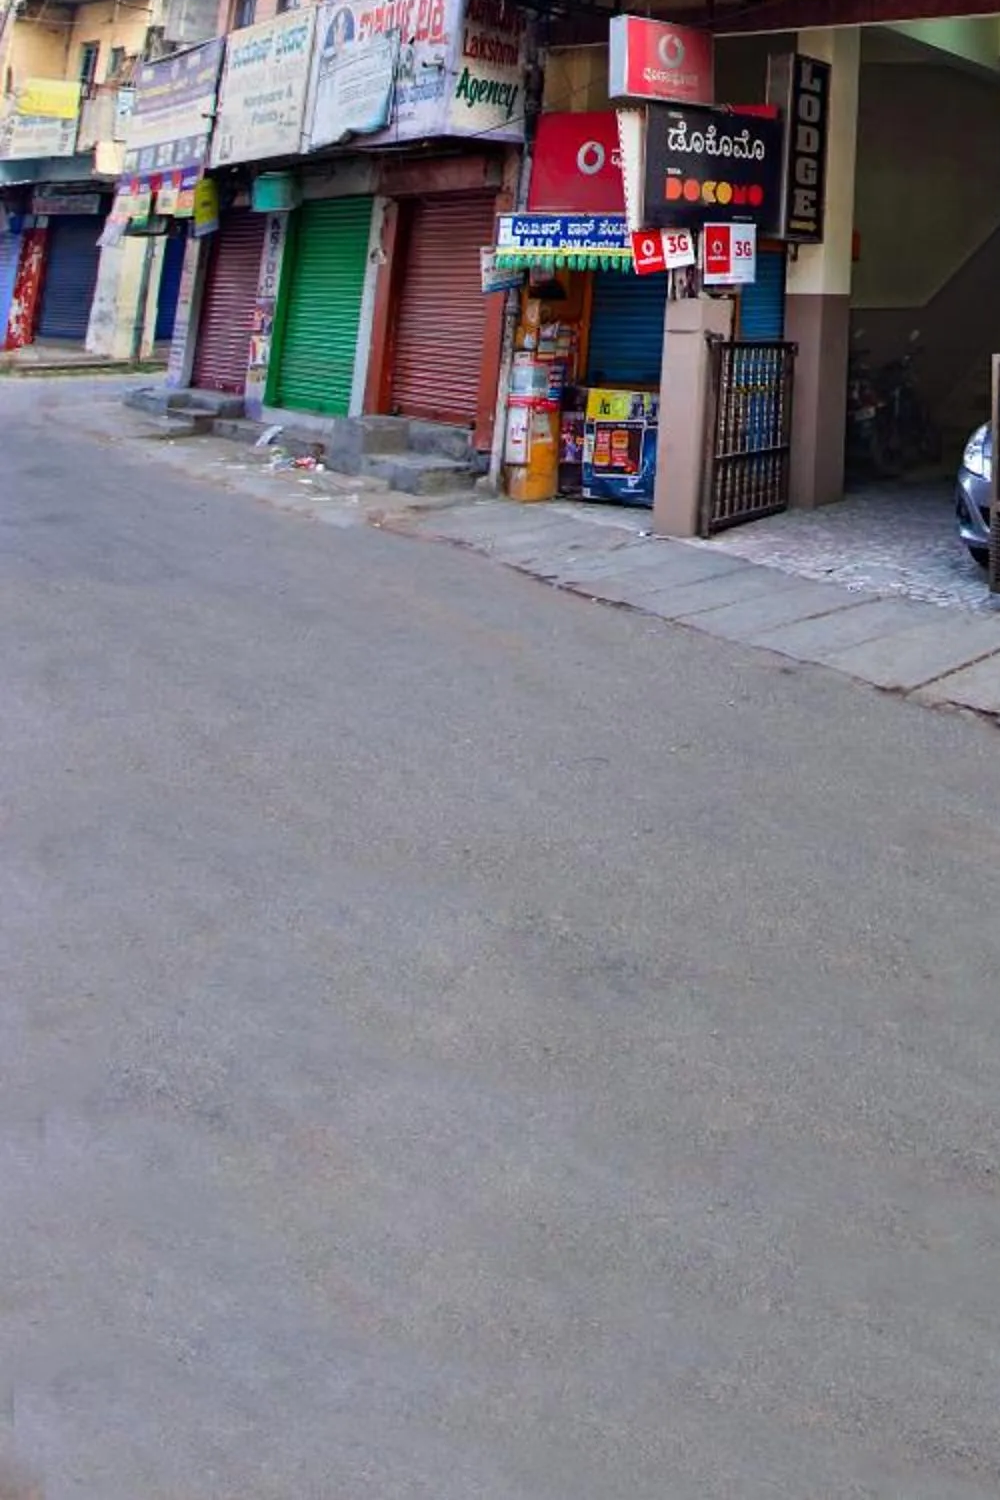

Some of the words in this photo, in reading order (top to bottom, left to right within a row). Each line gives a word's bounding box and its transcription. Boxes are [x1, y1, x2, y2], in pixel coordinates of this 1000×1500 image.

[456, 67, 519, 119] Agency
[793, 61, 823, 218] LODGE
[665, 176, 764, 207] DOCOMO
[667, 233, 690, 254] 3G
[735, 240, 753, 257] 3G
